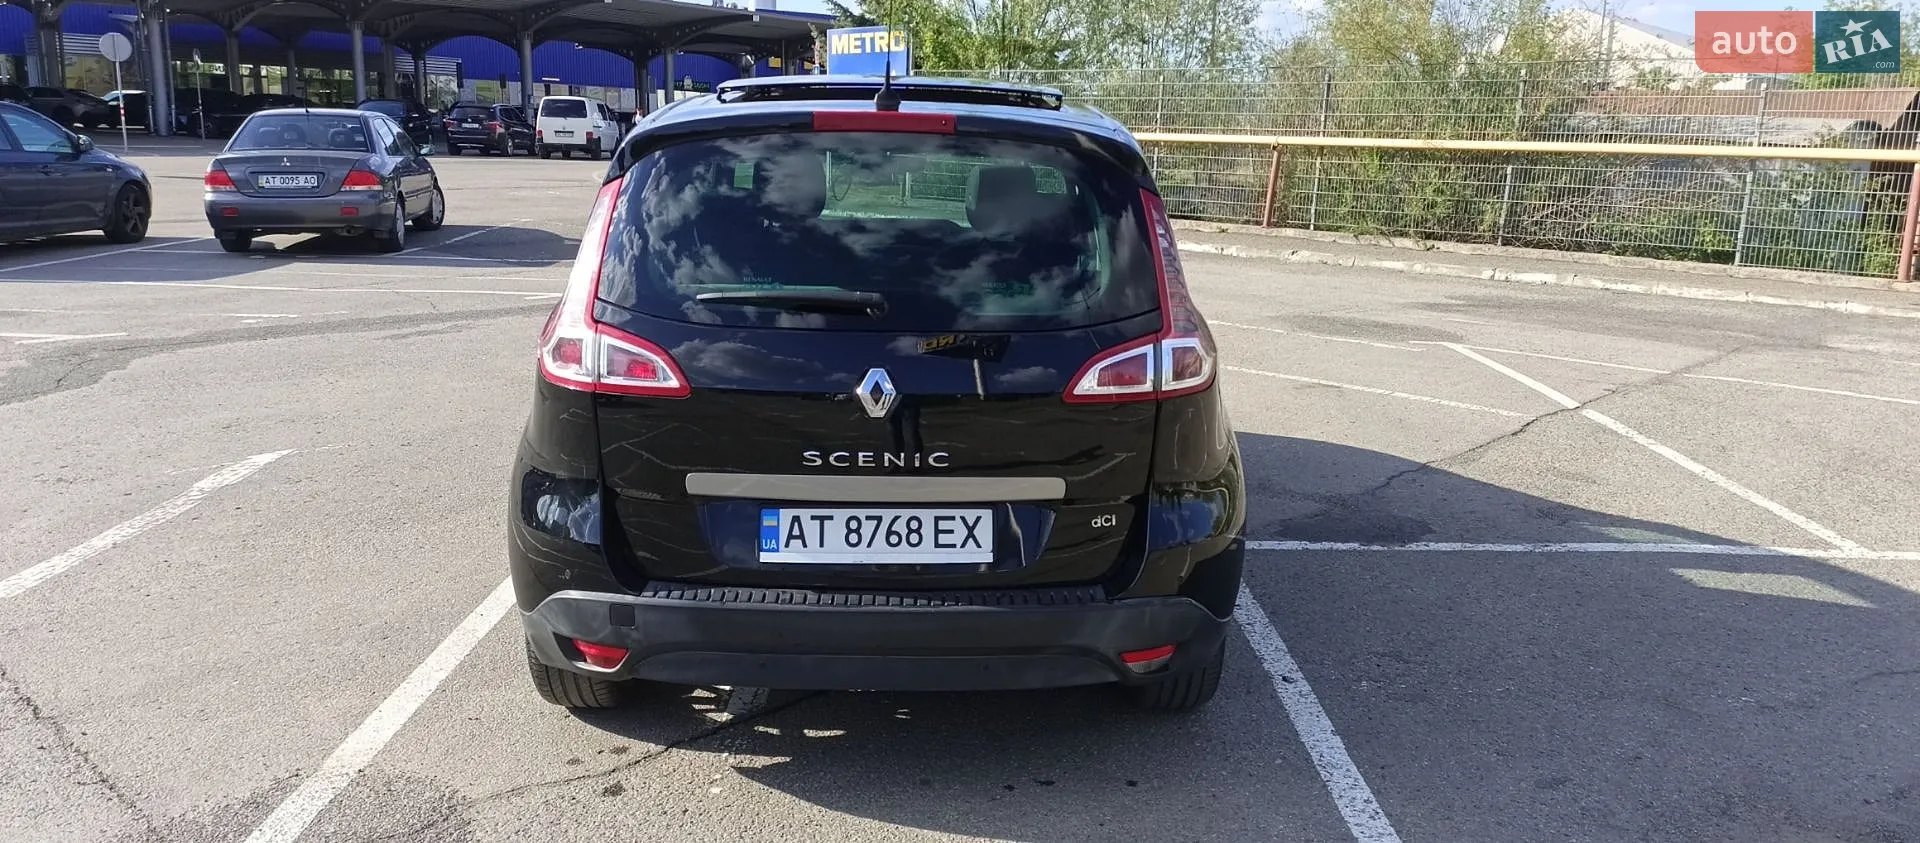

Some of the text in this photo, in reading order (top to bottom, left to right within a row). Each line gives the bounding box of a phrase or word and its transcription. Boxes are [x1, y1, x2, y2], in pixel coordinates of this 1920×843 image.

[832, 31, 905, 54] METRO
[265, 176, 316, 184] AT 0095 AO
[802, 451, 950, 468] SCENIC
[784, 515, 983, 549] AT 8768 EX
[762, 539, 778, 550] UA
